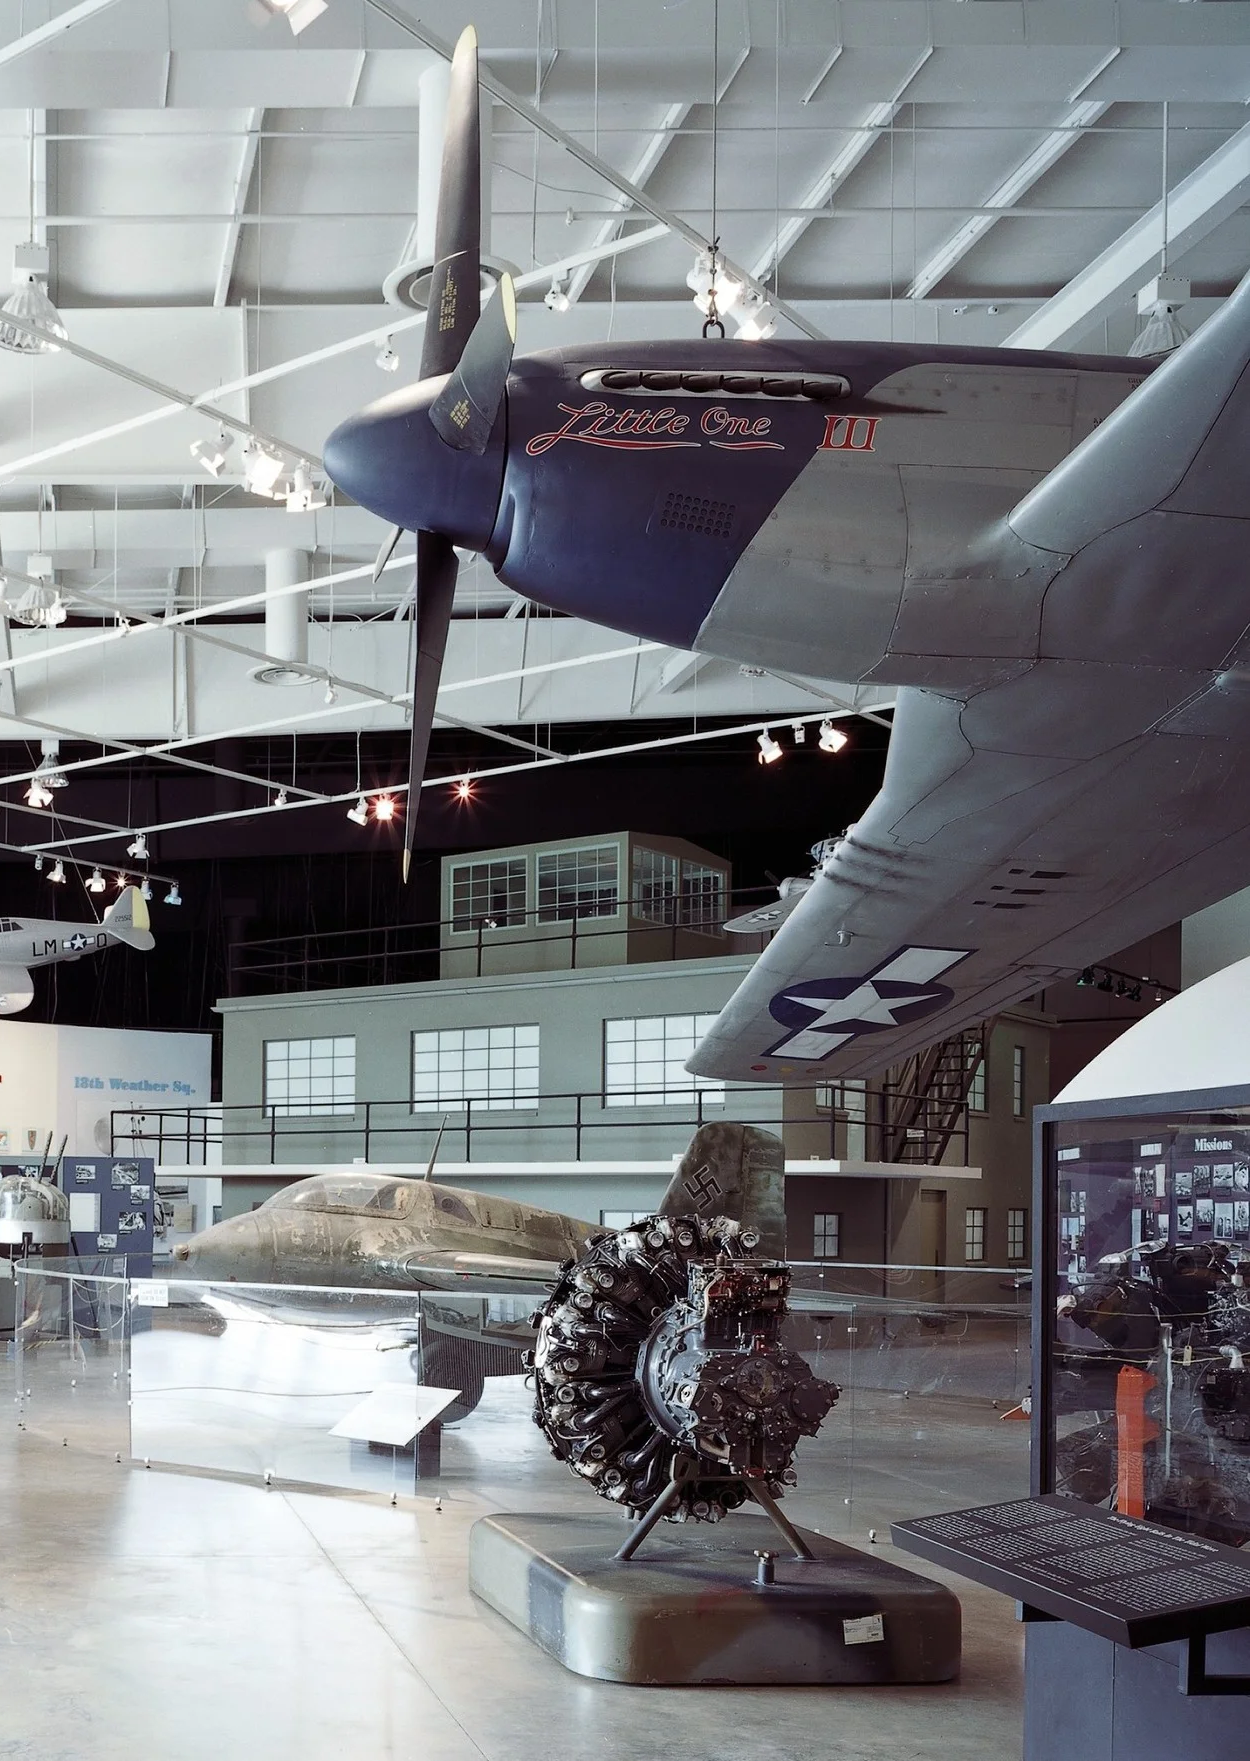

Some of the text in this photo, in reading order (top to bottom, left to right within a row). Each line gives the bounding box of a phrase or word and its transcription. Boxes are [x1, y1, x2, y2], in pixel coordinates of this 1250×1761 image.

[526, 402, 882, 455] Little One III
[33, 939, 57, 957] LM
[74, 1076, 196, 1096] 18th Weather Sq.
[1194, 1137, 1233, 1152] Missions
